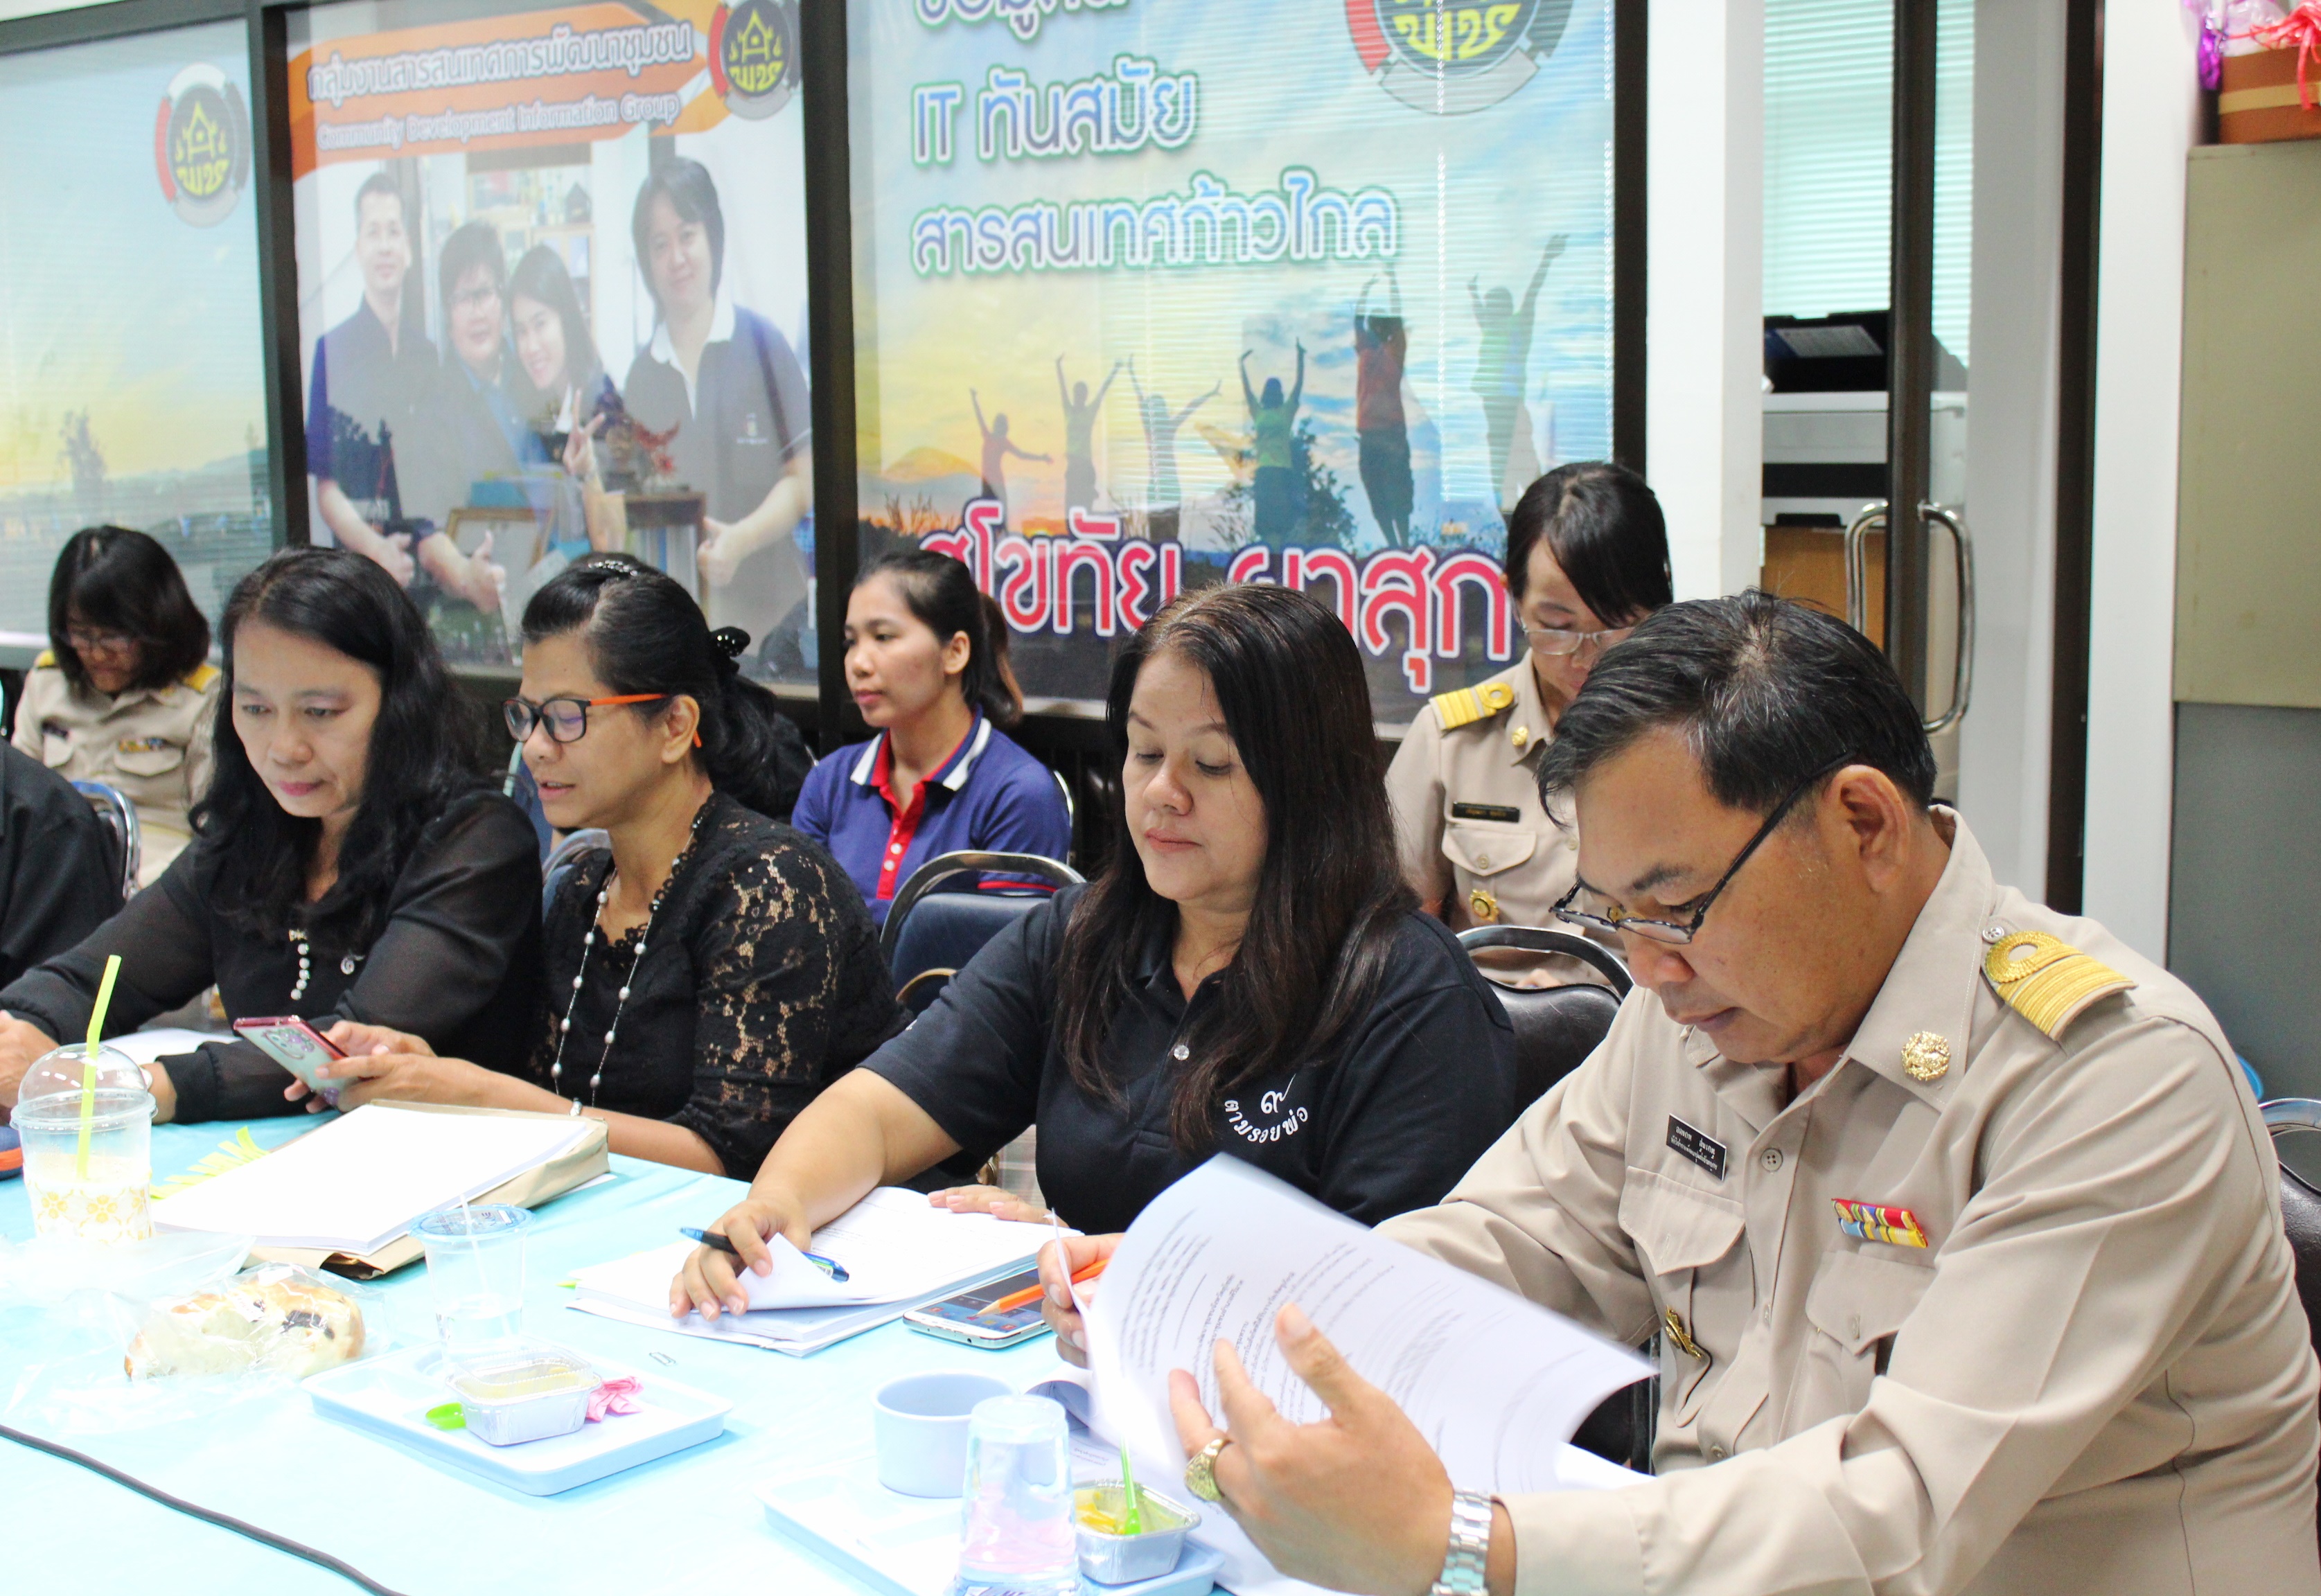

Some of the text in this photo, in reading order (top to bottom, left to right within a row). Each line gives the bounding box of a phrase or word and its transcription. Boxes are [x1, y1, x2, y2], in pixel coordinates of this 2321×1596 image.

[318, 92, 681, 150] Community Development Information Group
[912, 56, 1197, 161] IT ทันสมัย
[913, 170, 1396, 272] สารสนเทศก้าวไกล
[920, 498, 1181, 637] โขทัย
[1224, 1099, 1308, 1143] ตามรอยพ่อ
